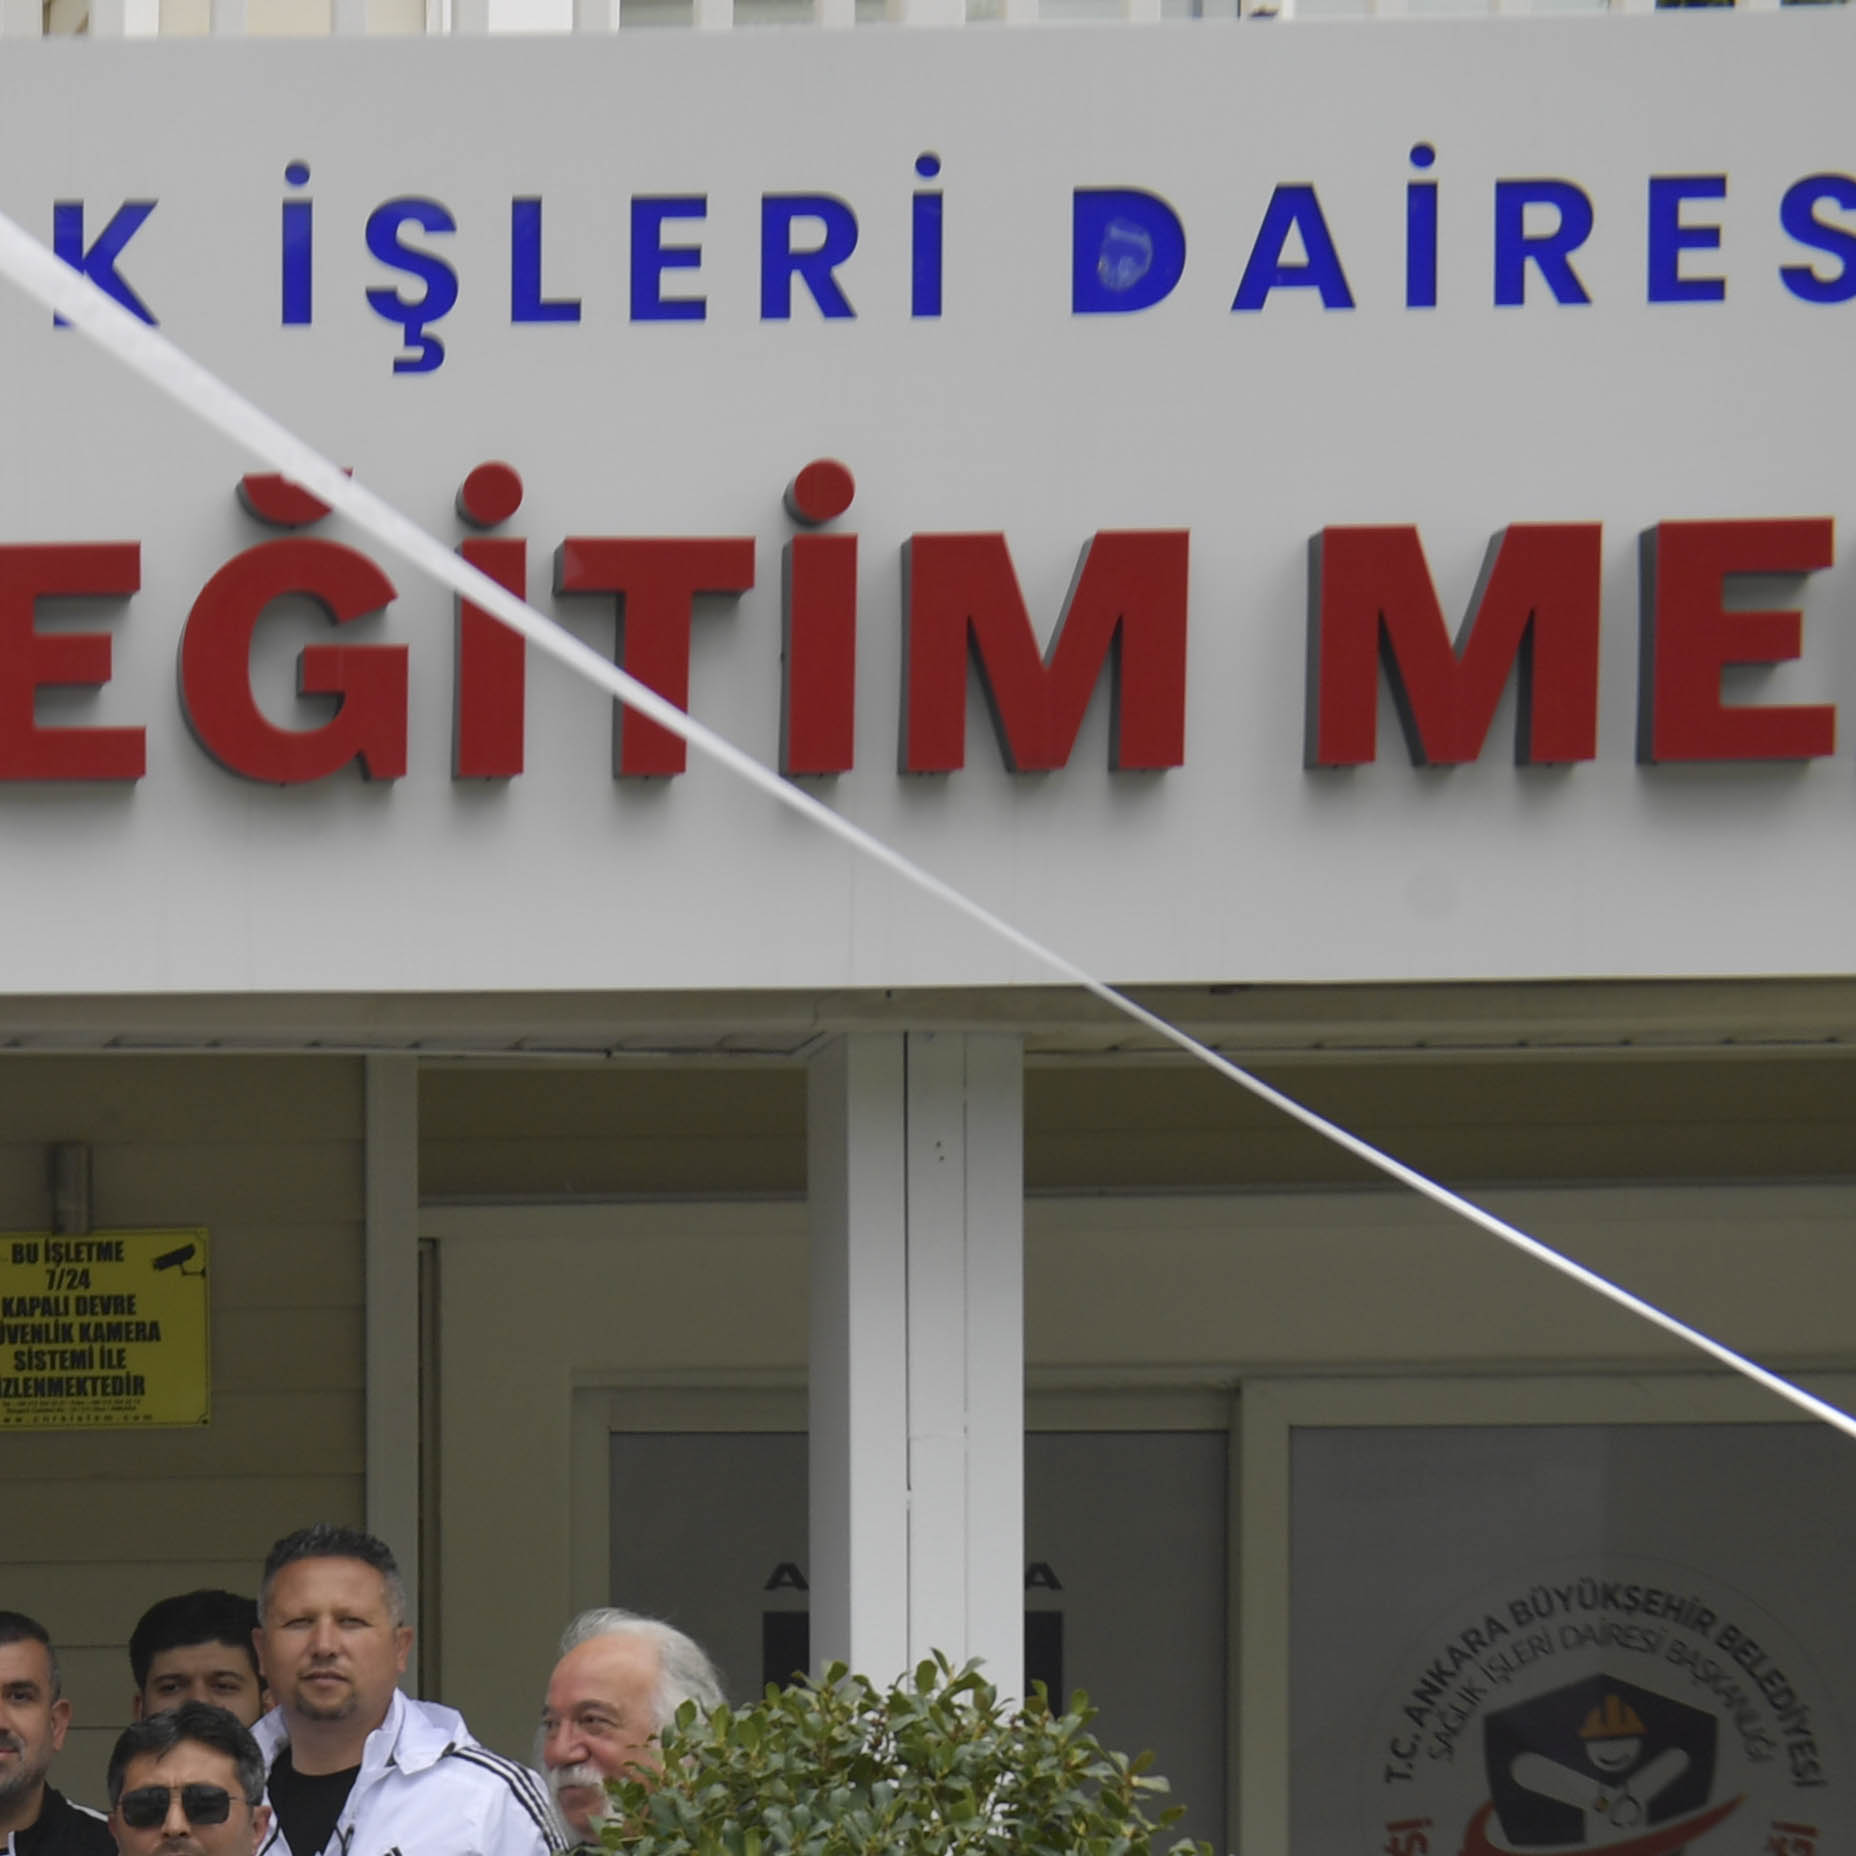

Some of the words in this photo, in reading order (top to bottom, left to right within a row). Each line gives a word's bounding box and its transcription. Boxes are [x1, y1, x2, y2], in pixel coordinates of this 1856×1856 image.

[282, 155, 943, 374] İŞLERİ
[1071, 145, 1856, 314] DAİRES
[1308, 520, 1837, 766] ME
[12, 1243, 39, 1265] BU
[44, 1239, 125, 1268] İŞLETME
[45, 1268, 91, 1291] 7/24
[2, 1296, 69, 1319] KAPALI
[75, 1294, 137, 1317] DEVRE
[79, 1320, 162, 1343] KAMERA
[14, 1345, 94, 1372] SİSTEMİ
[99, 1343, 127, 1371] İLE
[1506, 1577, 1719, 1640] BÜYÜKŞEHİR
[1403, 1613, 1510, 1730] ANKARA
[1715, 1624, 1828, 1789] BELEDİYESİ
[1385, 1730, 1422, 1785] T.C.
